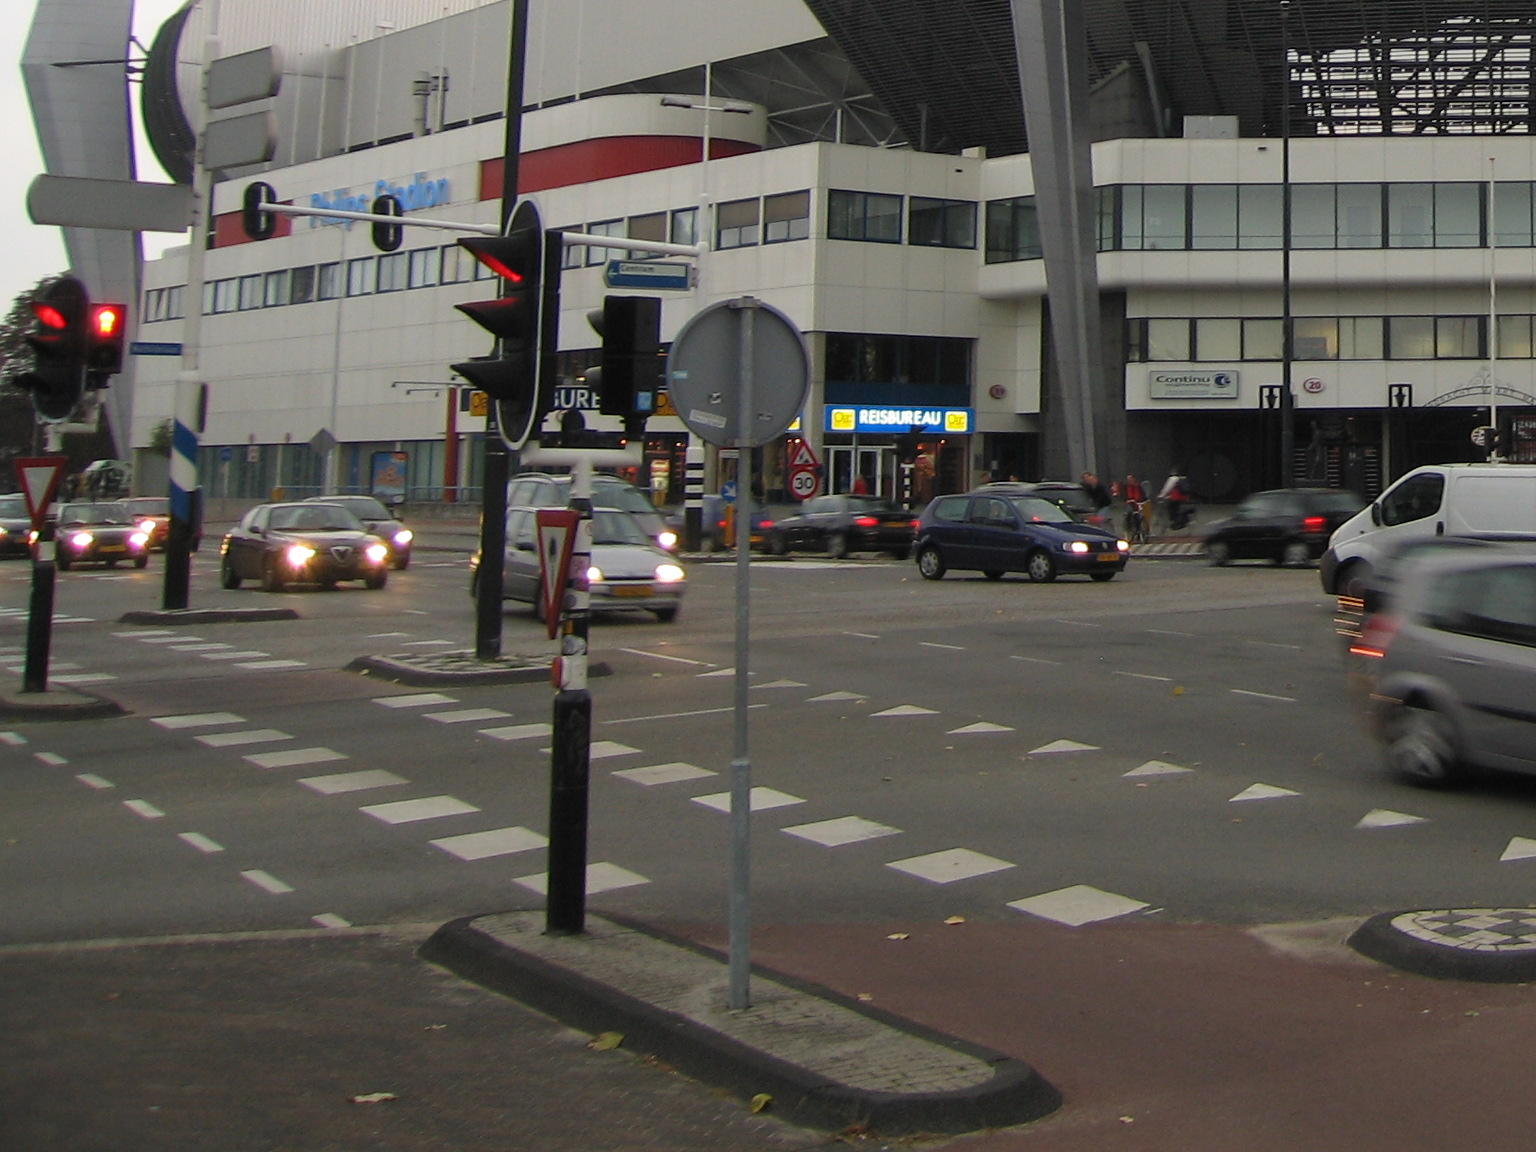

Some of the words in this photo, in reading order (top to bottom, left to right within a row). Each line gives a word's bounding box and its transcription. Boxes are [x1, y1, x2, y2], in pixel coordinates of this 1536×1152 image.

[1156, 375, 1211, 383] Continu
[859, 409, 942, 425] REISBUREAU
[794, 477, 814, 490] 30
